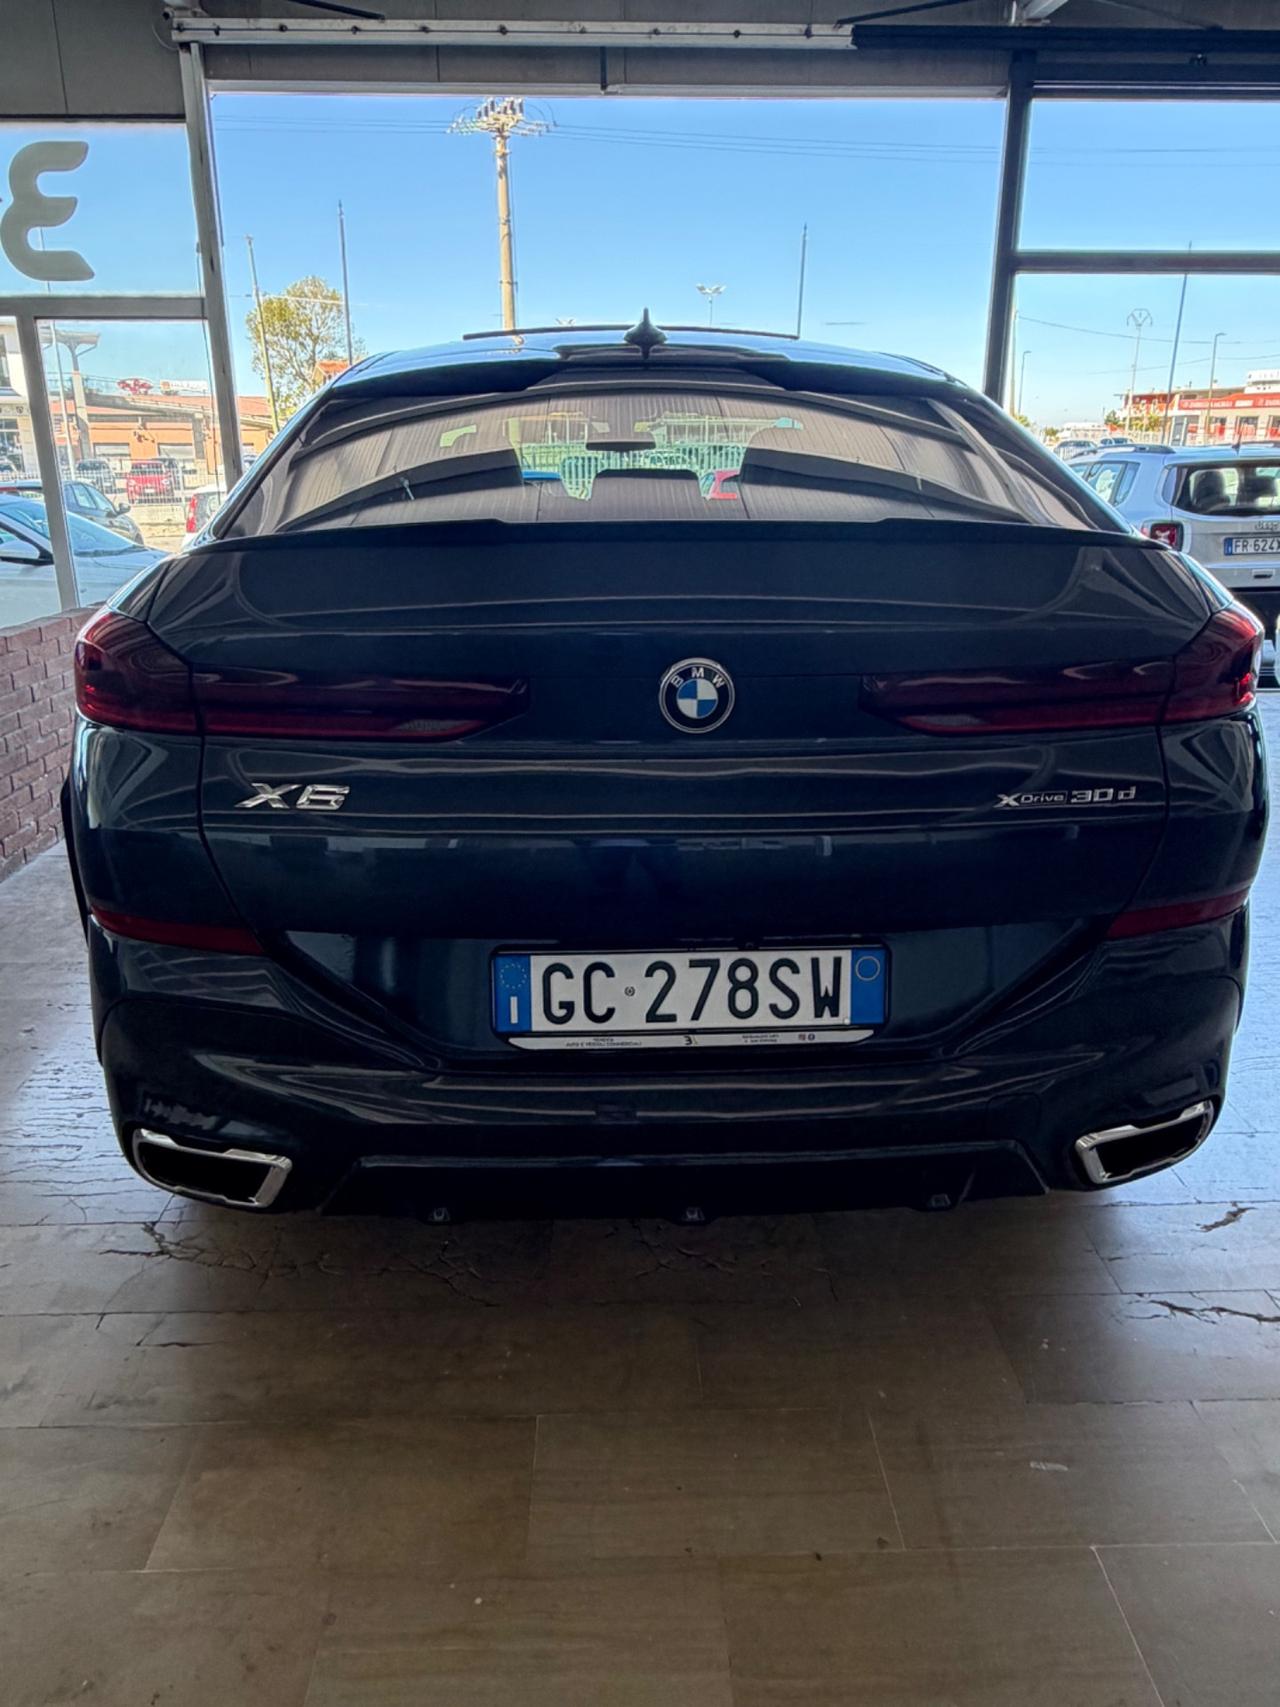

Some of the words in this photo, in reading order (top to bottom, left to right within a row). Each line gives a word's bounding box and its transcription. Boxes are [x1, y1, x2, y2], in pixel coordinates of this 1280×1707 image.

[1234, 540, 1249, 553] FR
[670, 666, 726, 688] BMW
[234, 782, 350, 811] X6
[542, 961, 615, 1025] GC
[644, 956, 842, 1023] 278SW
